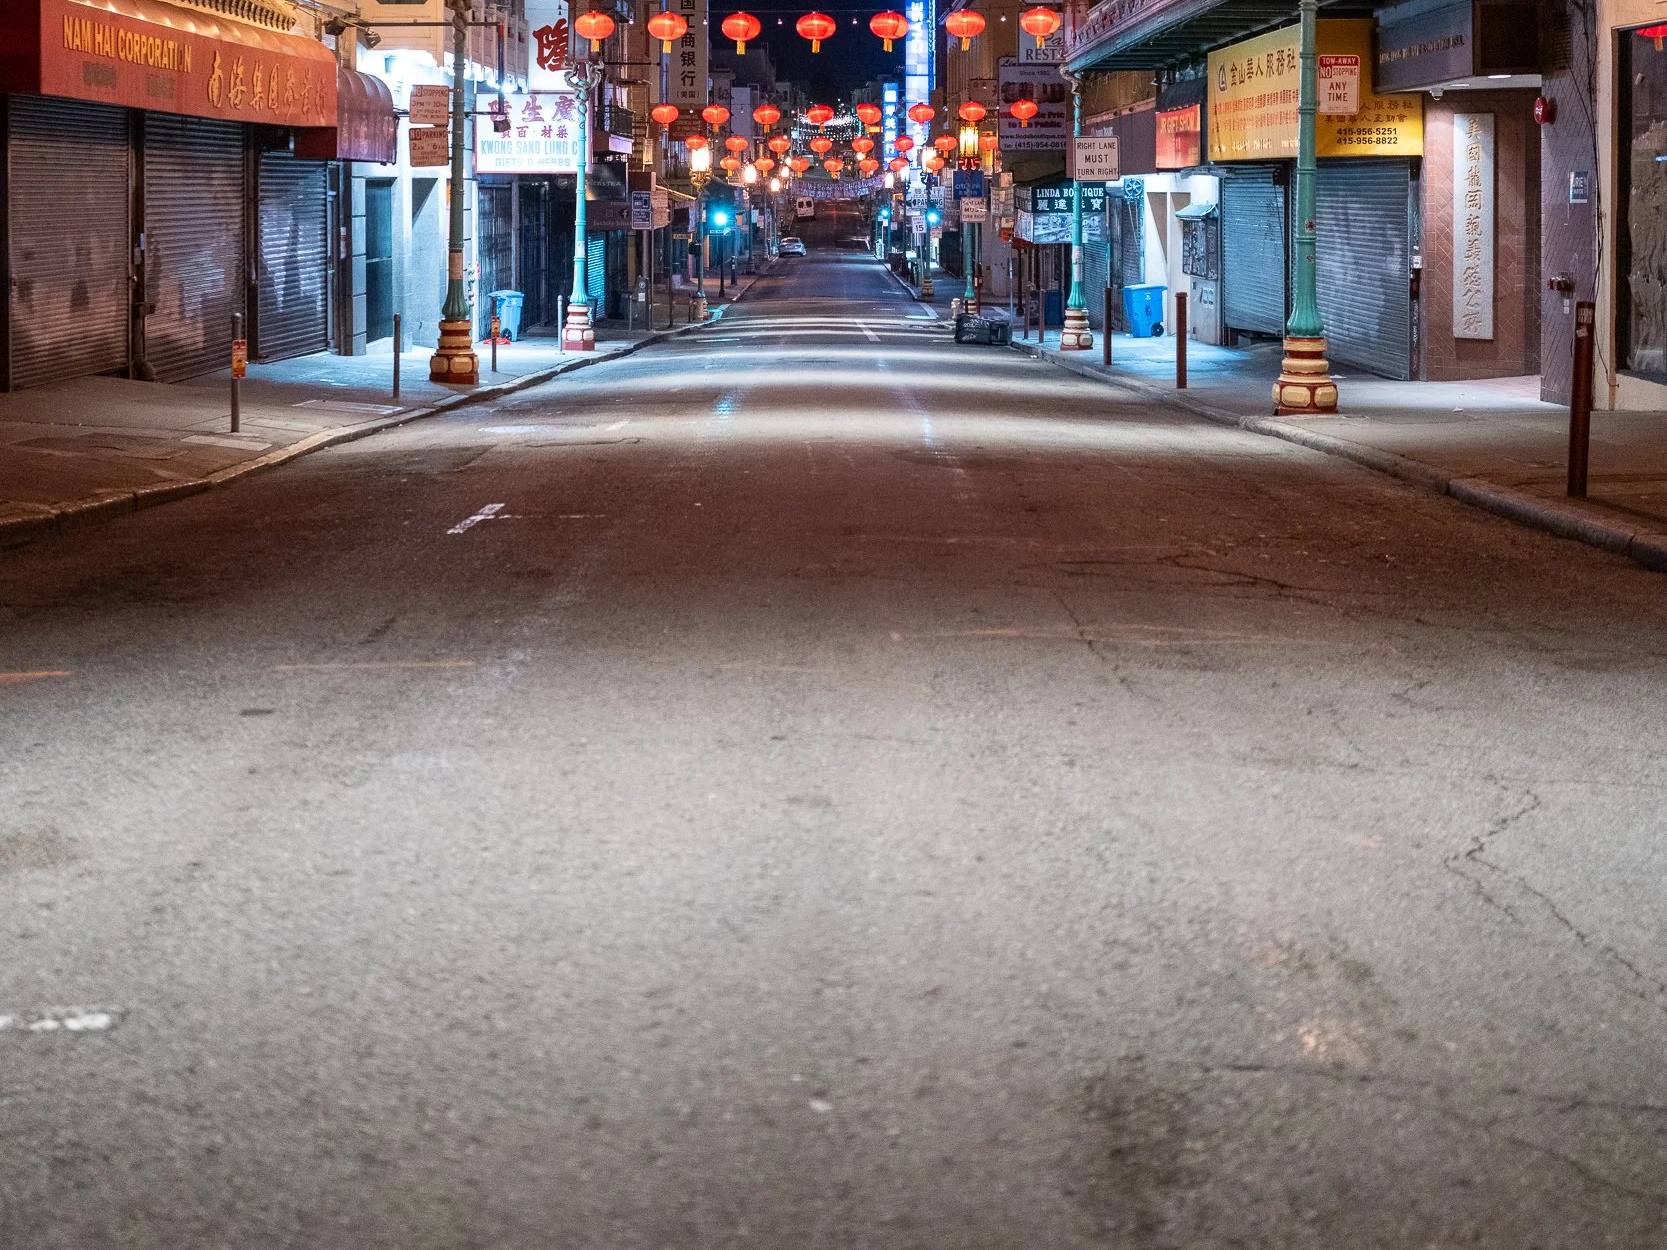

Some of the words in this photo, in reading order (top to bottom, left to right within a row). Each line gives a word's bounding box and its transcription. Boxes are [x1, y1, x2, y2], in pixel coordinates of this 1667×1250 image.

[63, 14, 91, 53] NAM
[94, 22, 115, 58] HAI
[1323, 57, 1356, 65] TOW-AWAY
[1230, 48, 1297, 87] 金山華人服務社
[1319, 66, 1332, 79] NO
[1333, 67, 1357, 76] STOPPING
[1329, 82, 1347, 90] ANY
[422, 88, 447, 97] STOPPING
[1328, 92, 1348, 101] TIME
[1035, 120, 1062, 129] Public
[1180, 111, 1194, 130] SHOP
[411, 129, 421, 140] NO
[1336, 127, 1397, 136] 415-956-5251
[1336, 137, 1398, 145] 415-956-8822
[481, 140, 512, 155] KWONG
[517, 140, 541, 154] SANG
[544, 140, 568, 155] LUNG
[1077, 142, 1096, 150] RIGHT
[1098, 142, 1116, 150] LANE
[495, 158, 523, 167] GIFTS
[1085, 154, 1109, 163] MUST
[1077, 168, 1095, 176] TURN
[1097, 168, 1117, 176] RIGHT
[1036, 188, 1060, 198] LINDA
[1063, 188, 1104, 198] BOTIQUE
[1037, 198, 1103, 210] 麗達寶
